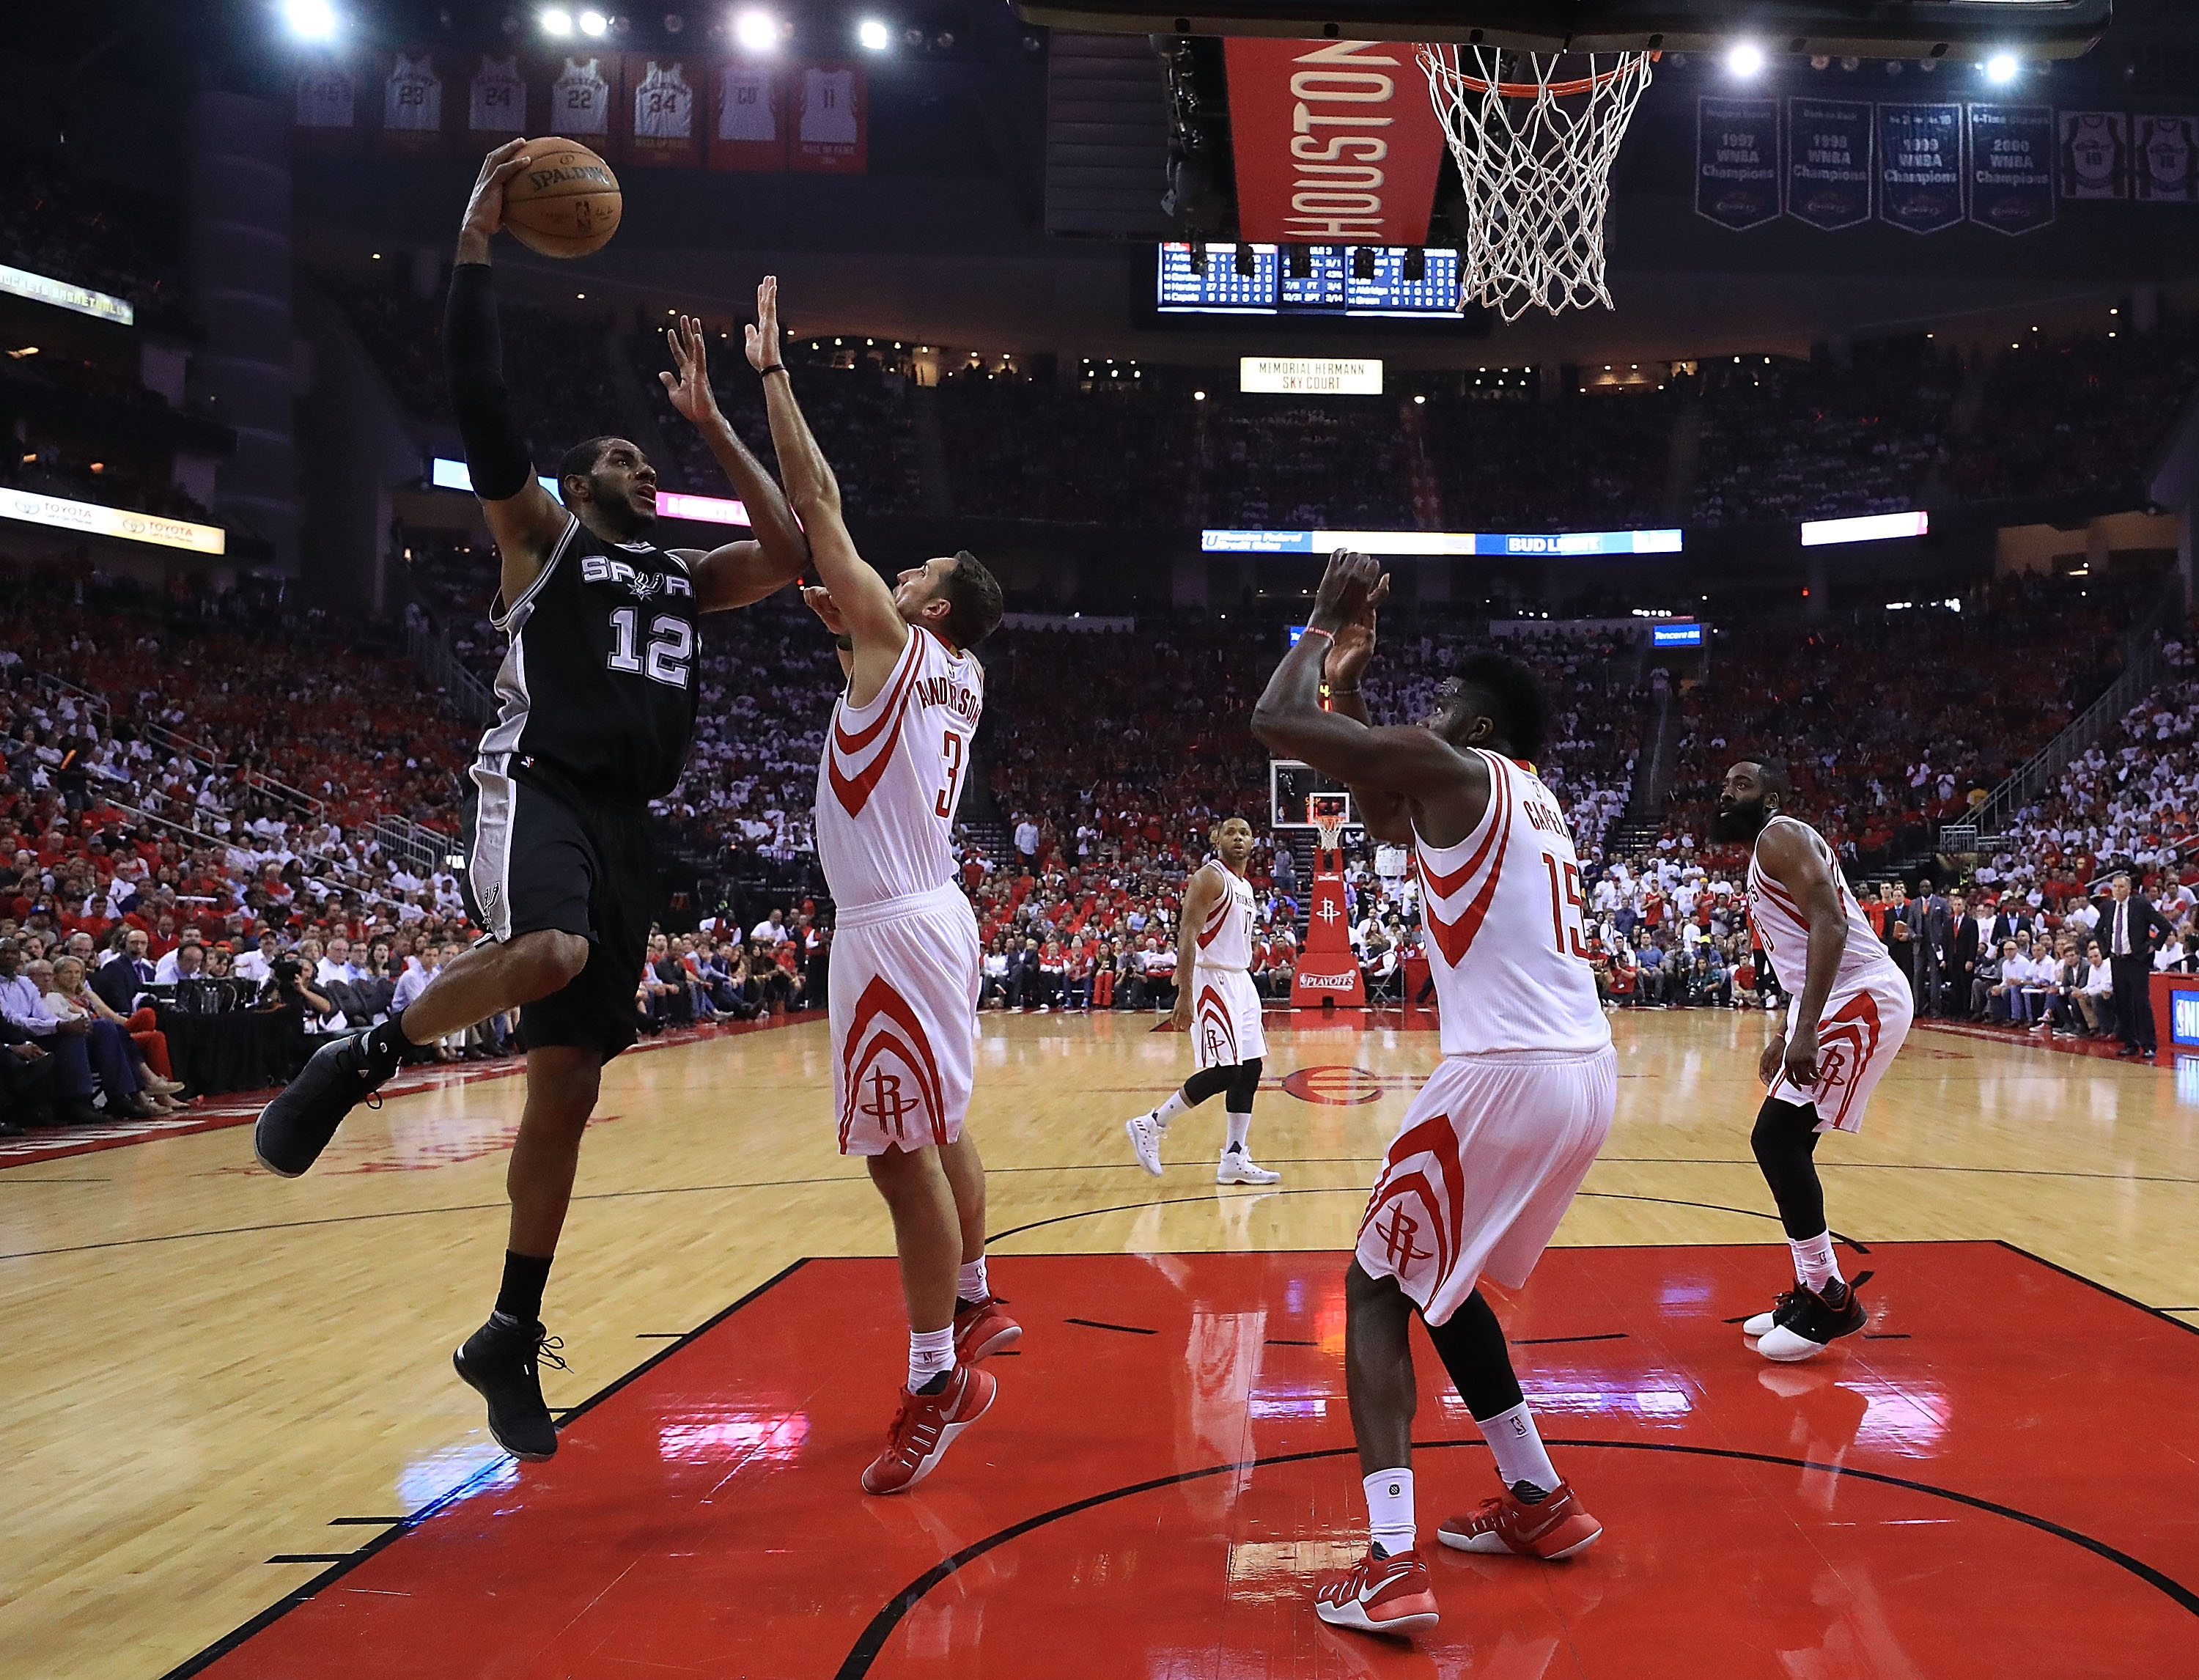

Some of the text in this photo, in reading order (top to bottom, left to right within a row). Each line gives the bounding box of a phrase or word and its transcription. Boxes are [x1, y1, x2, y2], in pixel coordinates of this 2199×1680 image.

[568, 89, 592, 109] 22
[649, 93, 676, 113] 34
[1722, 133, 1755, 147] 1997
[1813, 134, 1848, 148] 1998
[1993, 139, 2030, 152] 2000
[1717, 150, 1760, 163] WNBA
[1808, 150, 1852, 164] WNBA
[1899, 154, 1942, 167] WNBA
[1990, 155, 2034, 168] WNBA
[1702, 163, 1775, 181] Champions
[1793, 164, 1867, 183] Champions
[1884, 169, 1957, 185] Champions
[1976, 170, 2049, 187] Champions
[1259, 362, 1364, 375] MEMORIAL HERMANN
[1283, 376, 1340, 389] SKY COURT
[45, 502, 92, 518] TOYOTA
[150, 521, 194, 537] TOYOTA
[1510, 537, 1599, 552] BUD LIT
[581, 555, 694, 601] SPUR
[1654, 631, 1687, 640] Tencent
[606, 605, 692, 690] 12
[916, 677, 982, 728] ANDRSON
[935, 729, 962, 819] 3
[1523, 800, 1572, 841] CAPEL
[1541, 851, 1589, 959] 15
[1306, 976, 1355, 987] PLAYOFFS
